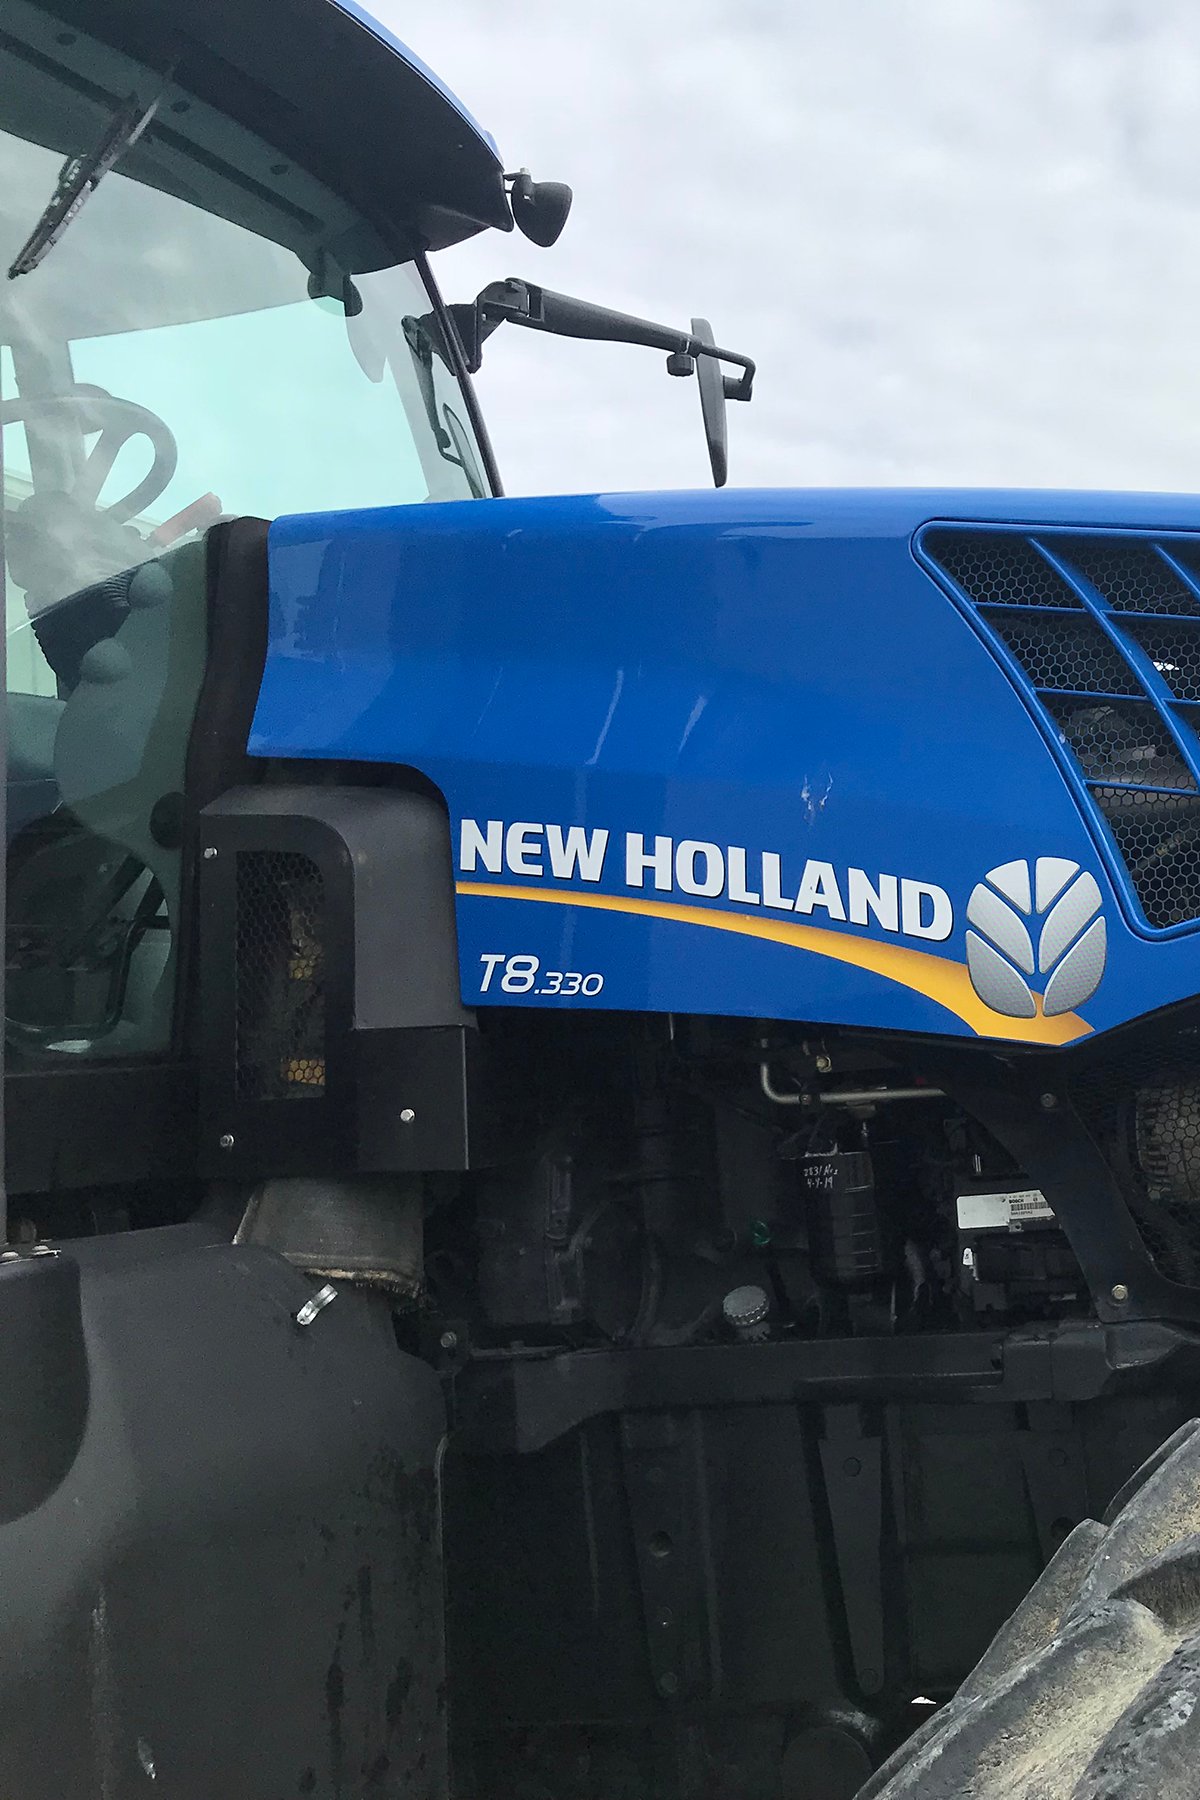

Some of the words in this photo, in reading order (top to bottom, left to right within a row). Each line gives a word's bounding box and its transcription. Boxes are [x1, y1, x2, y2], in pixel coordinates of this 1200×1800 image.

[458, 818, 609, 882] NEW
[626, 832, 954, 941] HOLLAND
[478, 953, 605, 997] T8.330
